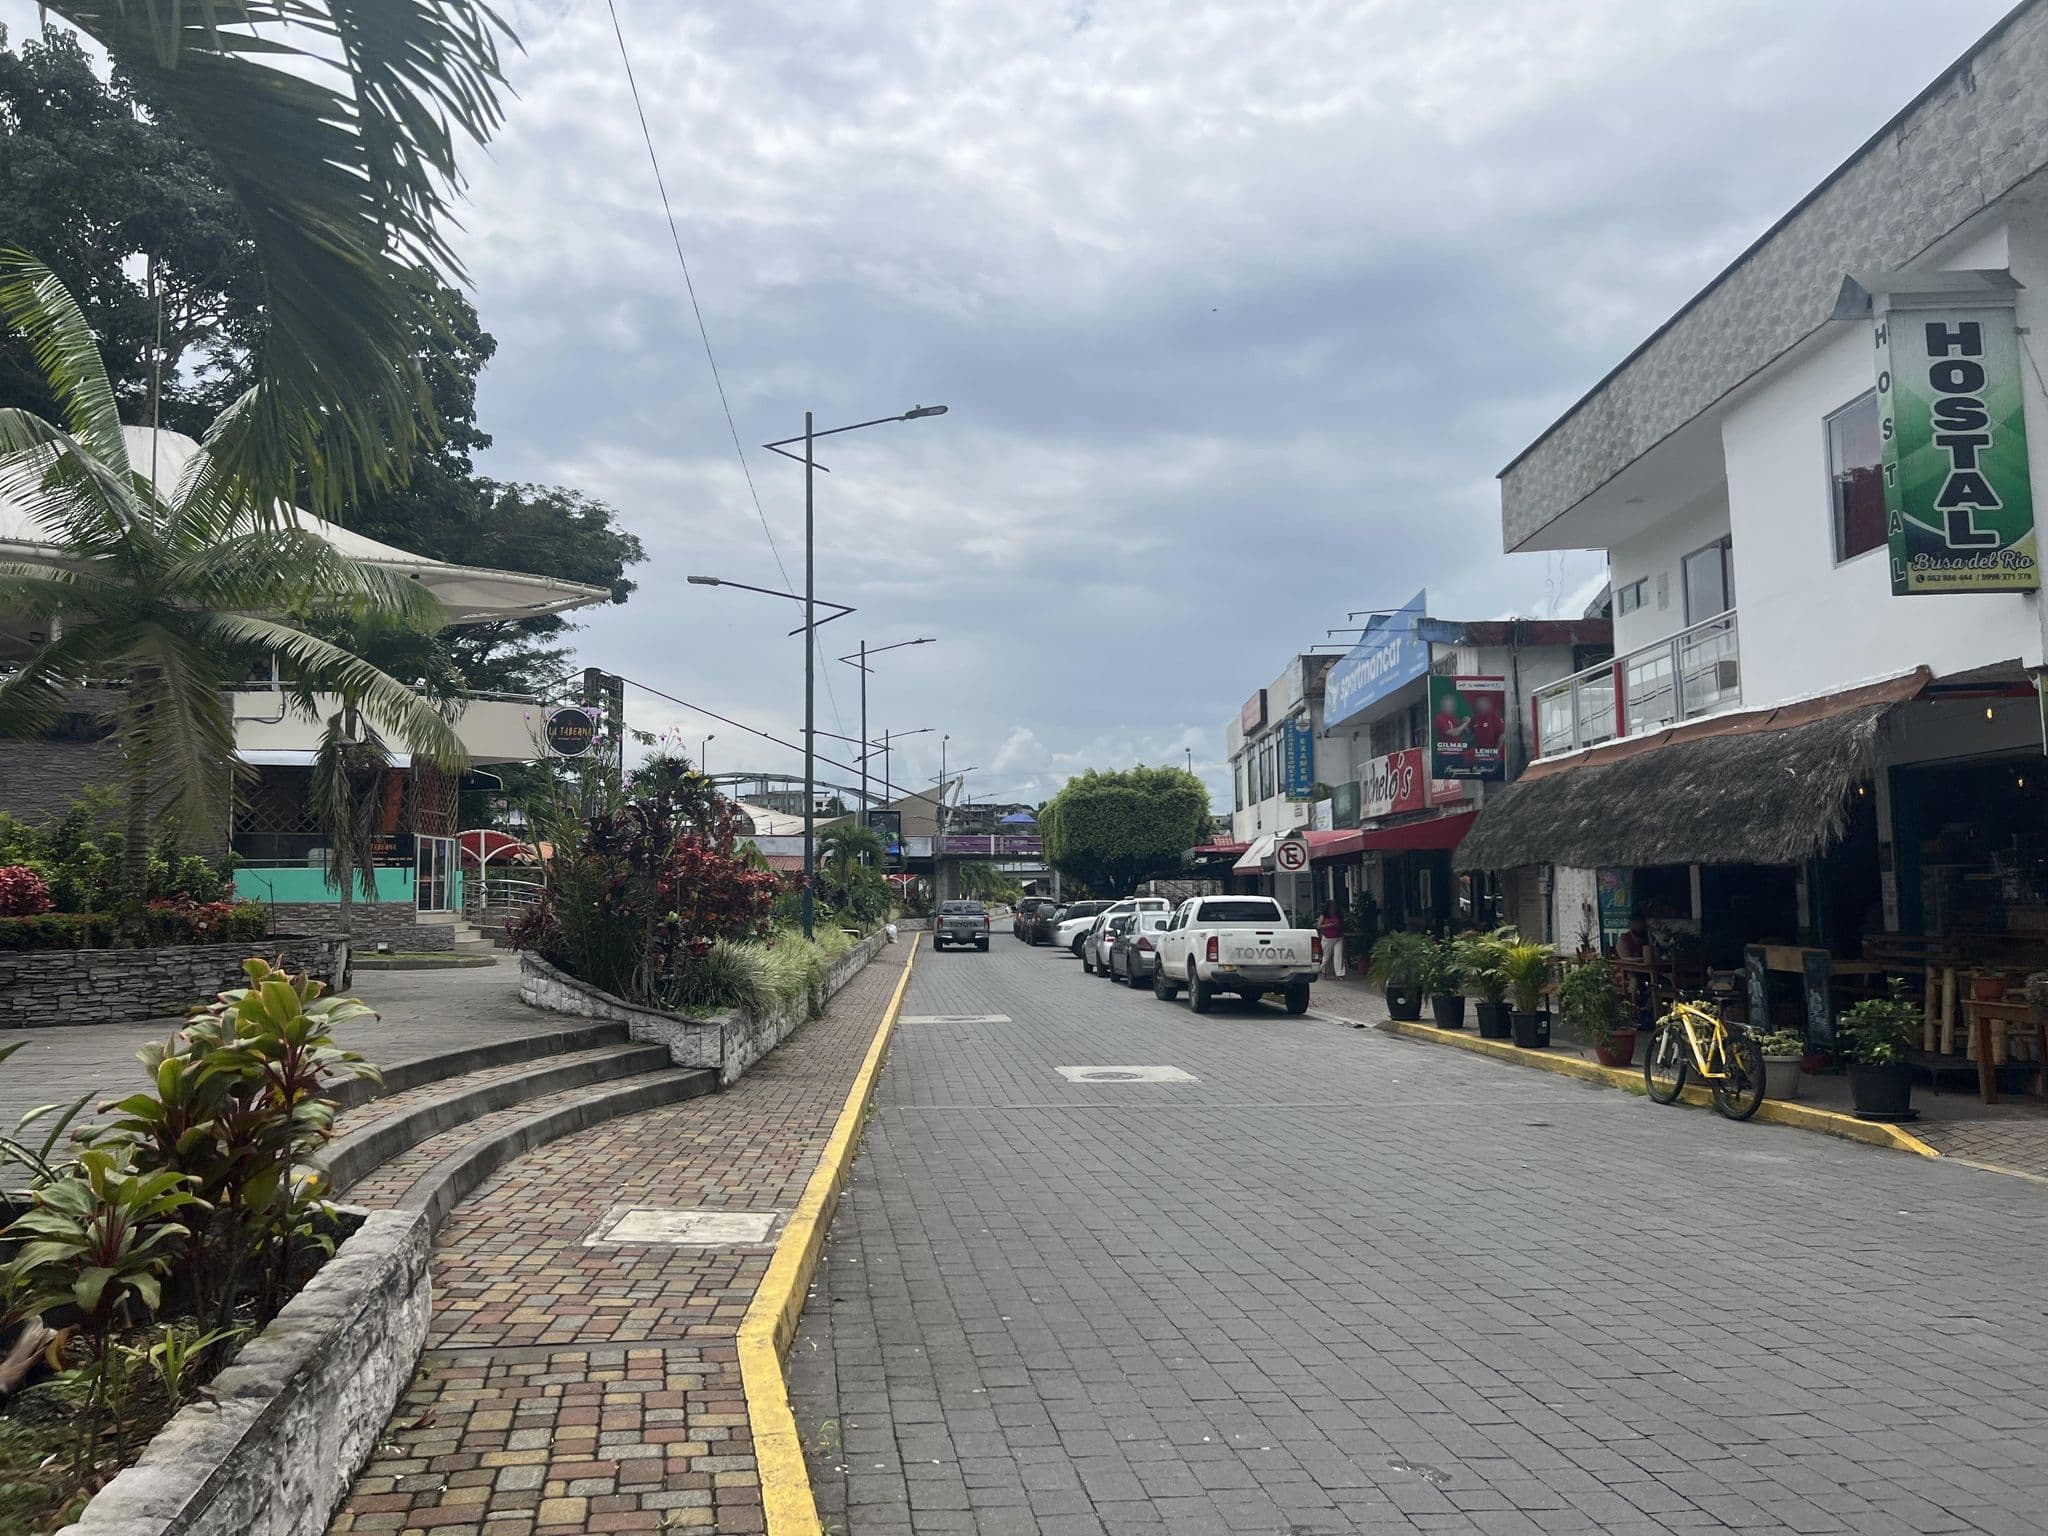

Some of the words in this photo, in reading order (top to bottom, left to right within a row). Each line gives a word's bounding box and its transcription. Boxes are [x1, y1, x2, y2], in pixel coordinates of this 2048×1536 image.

[1874, 323, 1905, 583] HOSTAL
[1925, 321, 2002, 547] HOSTAL
[1912, 553, 1963, 571] Brisa
[1967, 551, 1997, 570] del
[1234, 947, 1296, 960] TOYOTA
